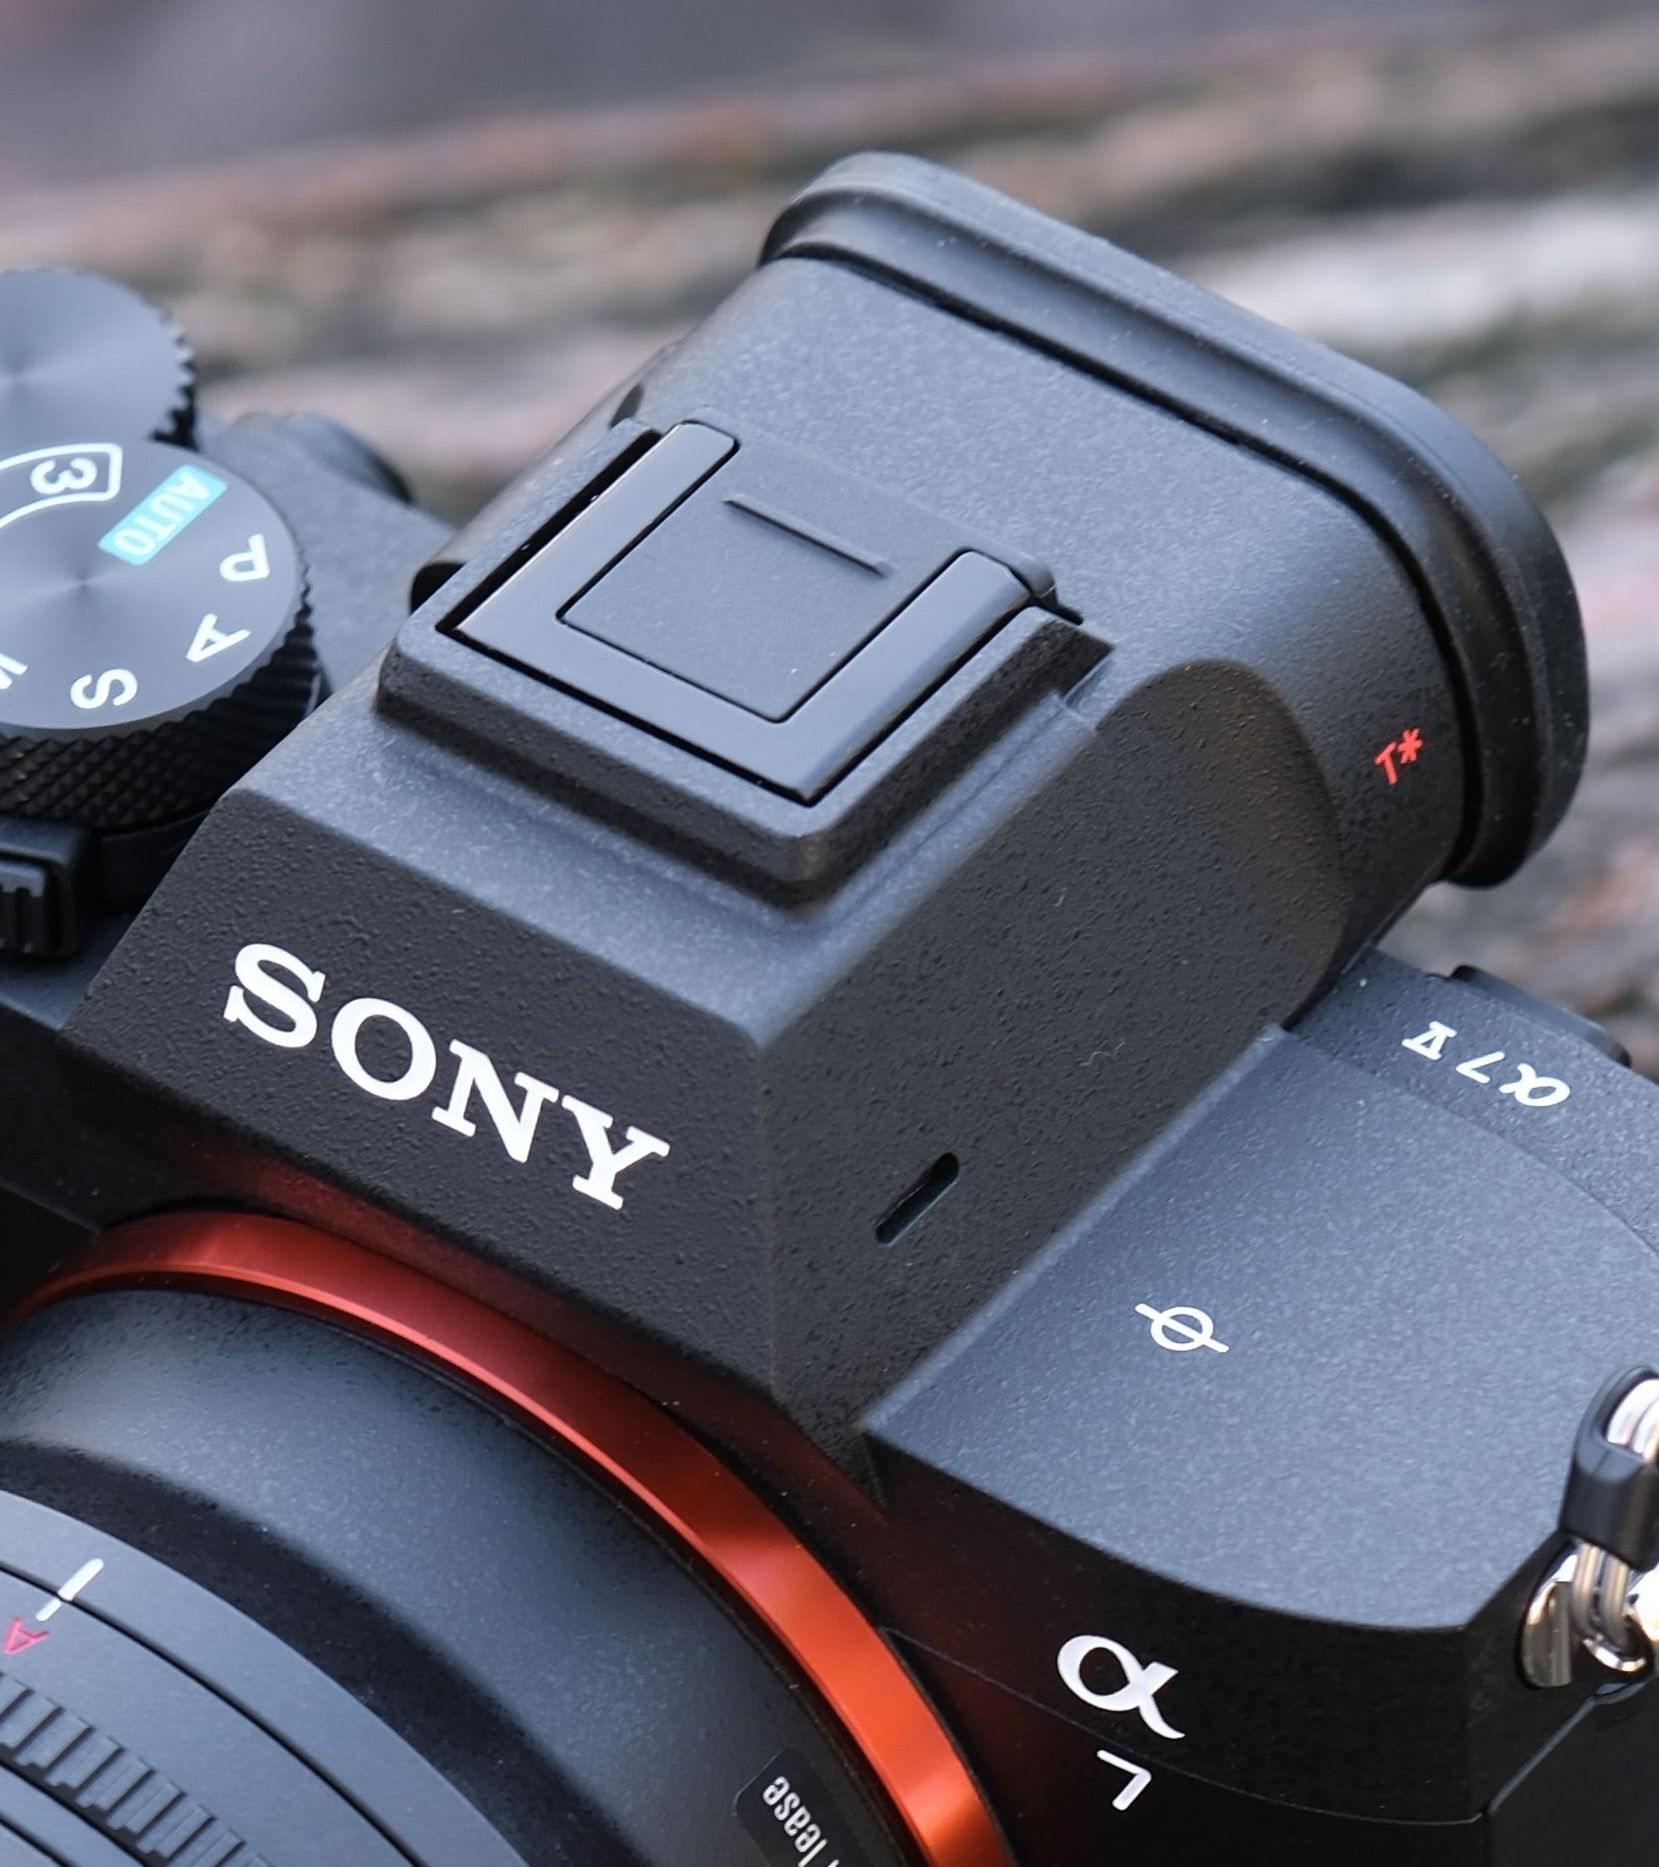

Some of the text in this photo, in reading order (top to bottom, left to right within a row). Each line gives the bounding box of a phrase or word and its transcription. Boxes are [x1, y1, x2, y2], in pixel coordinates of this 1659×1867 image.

[30, 457, 98, 495] 3
[114, 474, 211, 554] AUTO
[219, 534, 271, 582] P
[186, 613, 251, 663] A
[70, 668, 138, 709] S
[224, 942, 670, 1210] SONY
[3, 1617, 51, 1655] A
[1096, 1749, 1152, 1811] 7
